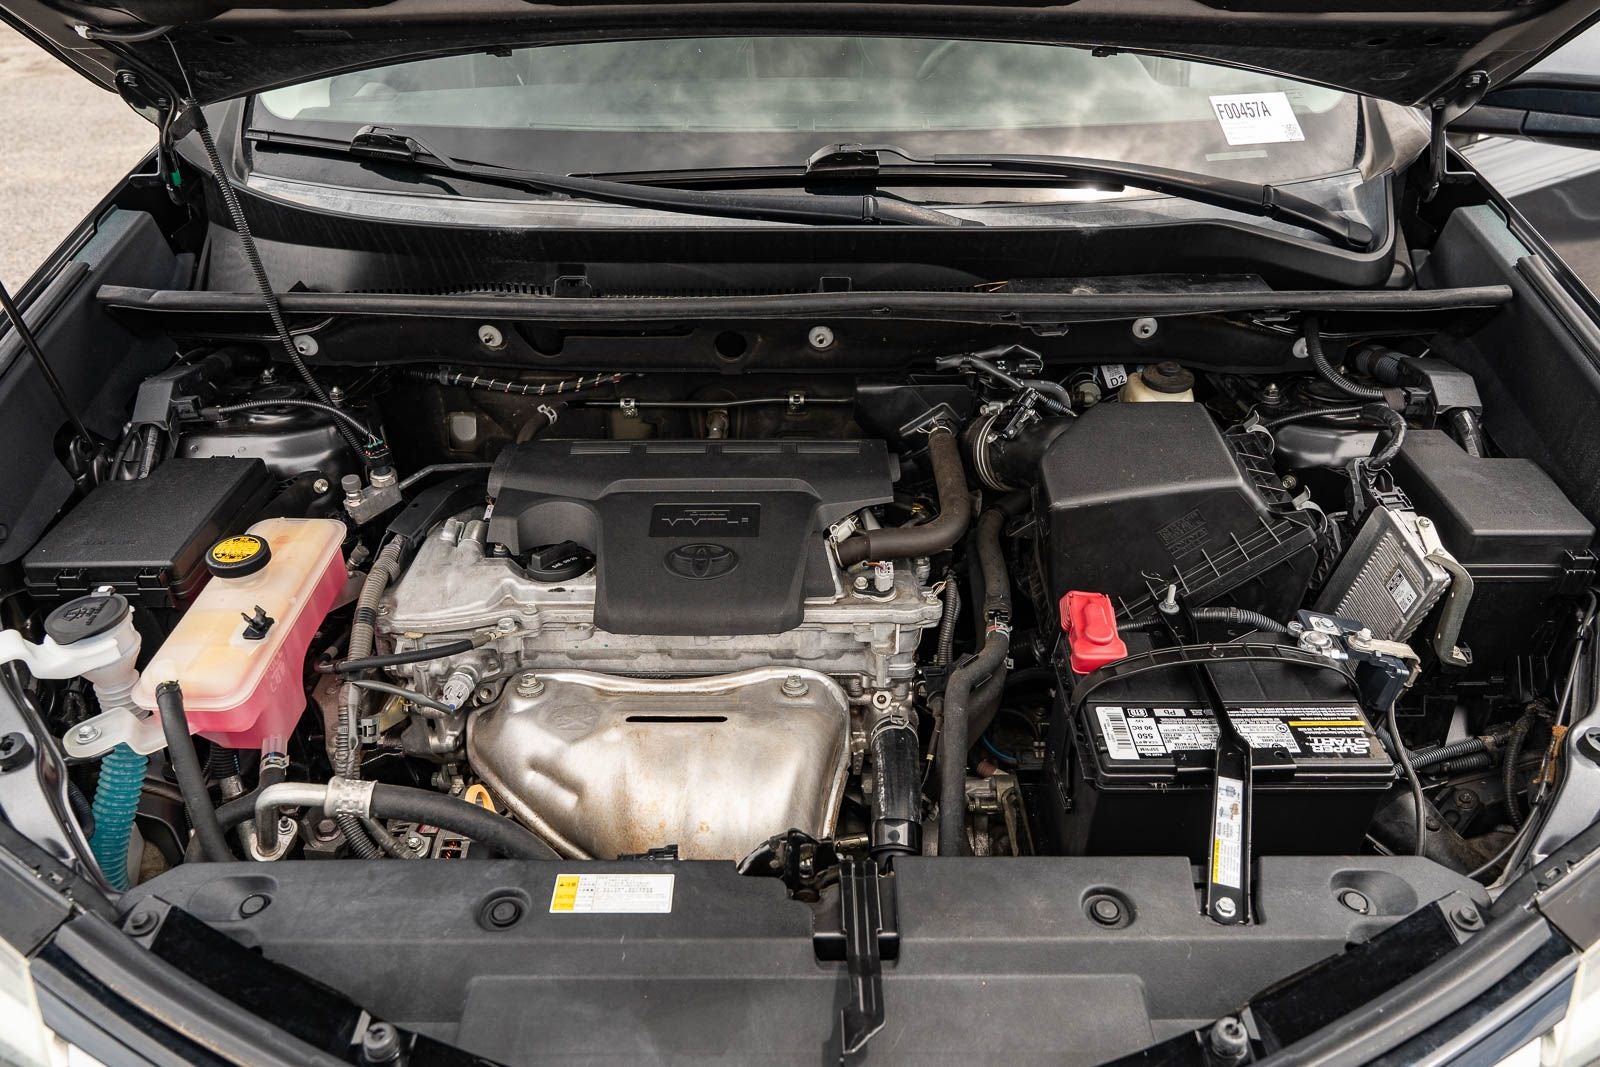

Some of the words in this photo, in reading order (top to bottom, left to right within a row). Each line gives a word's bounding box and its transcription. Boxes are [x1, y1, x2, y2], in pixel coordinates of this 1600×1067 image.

[1216, 101, 1271, 120] F00457A
[1110, 375, 1126, 387] D2
[1310, 737, 1370, 747] START
[1312, 745, 1368, 754] SUPER
